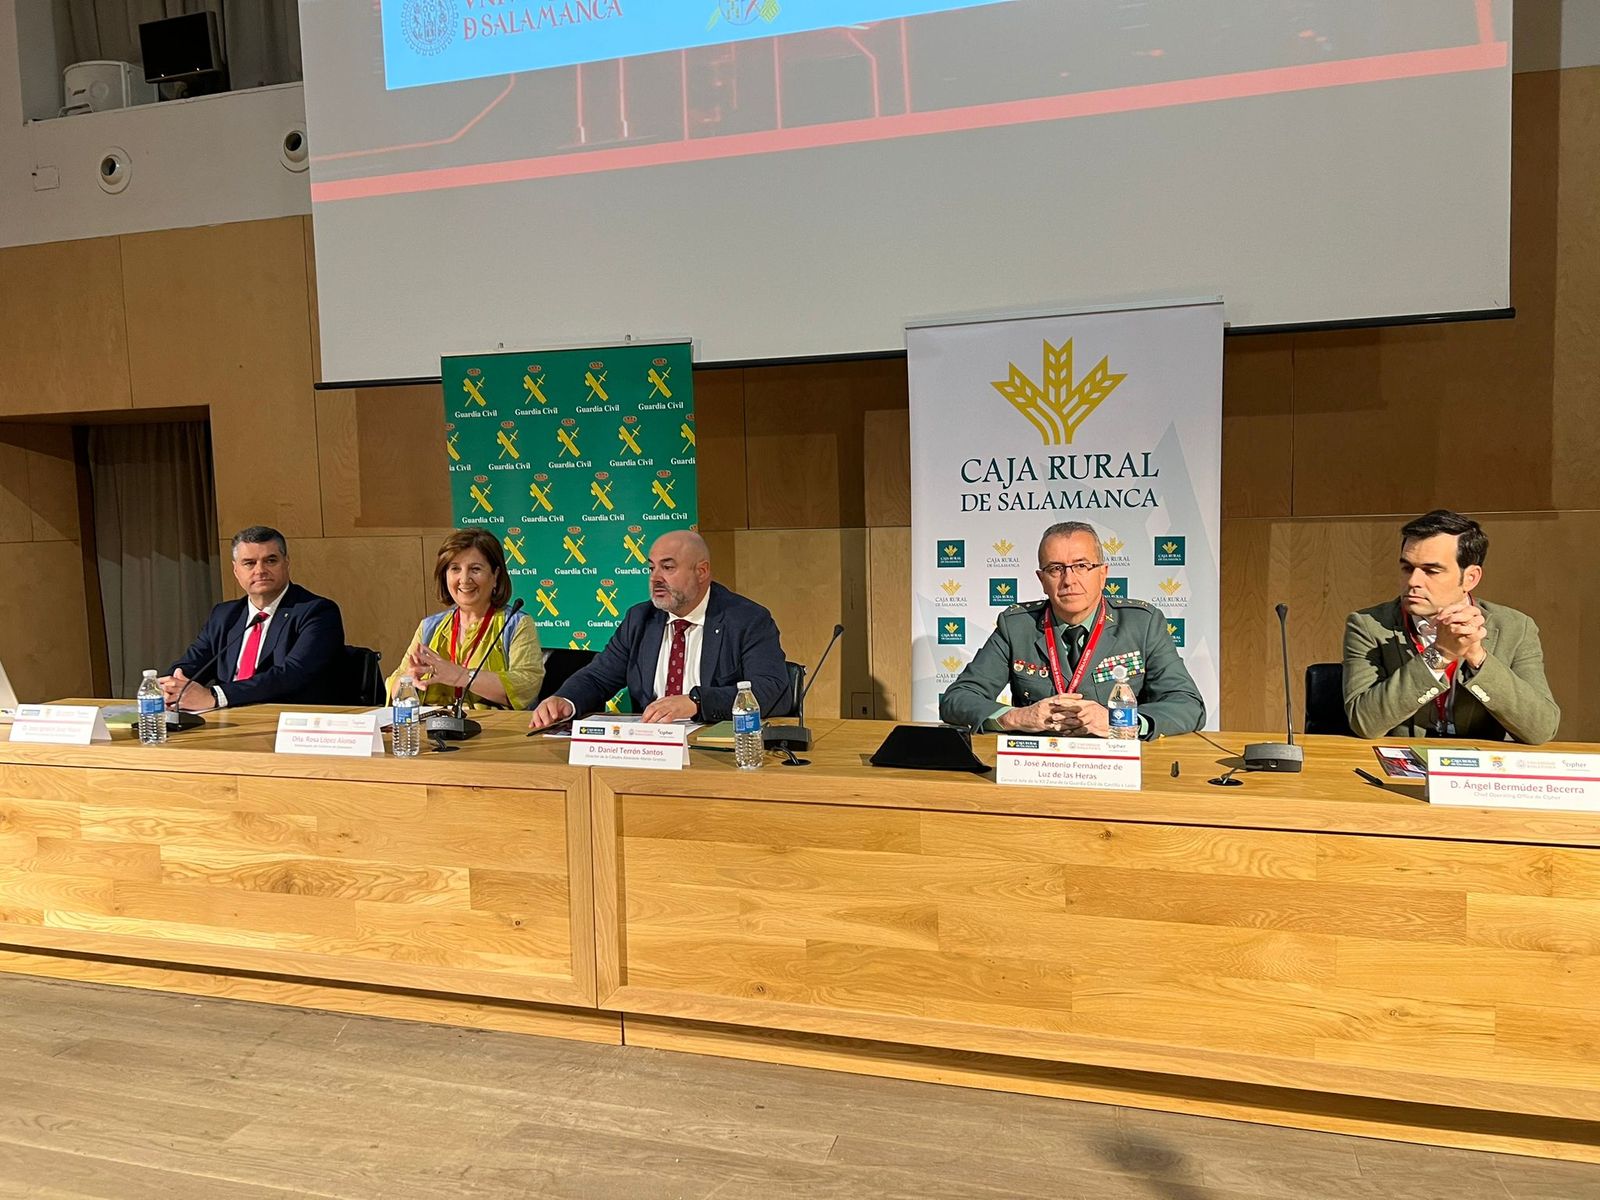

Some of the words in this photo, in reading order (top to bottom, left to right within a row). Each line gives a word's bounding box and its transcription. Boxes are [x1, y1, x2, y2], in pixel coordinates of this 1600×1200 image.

[481, 0, 623, 37] SALAMANCA
[576, 405, 603, 413] Guardia
[604, 404, 620, 412] Civil
[638, 402, 666, 410] Guardia
[667, 401, 684, 409] Civil
[514, 408, 541, 416] Guardia
[542, 407, 558, 415] Civil
[548, 461, 575, 469] Guardia
[609, 459, 636, 467] Guardia
[637, 458, 654, 466] Civil
[670, 457, 696, 465] Guardi
[961, 456, 1038, 489] CAJA
[1048, 452, 1160, 480] RURAL
[961, 493, 992, 512] DE
[998, 488, 1160, 511] SALAMANCA
[462, 516, 488, 524] Guardia
[521, 515, 547, 523] Guardia
[581, 514, 608, 522] Guardia
[642, 513, 670, 521] Guardia
[671, 512, 688, 520] Civil
[614, 567, 641, 575] Guardia
[587, 620, 614, 628] Guardia
[598, 746, 618, 754] Daniel
[620, 747, 641, 755] Terrón
[642, 748, 664, 756] Santos
[1014, 759, 1021, 767] D.
[1024, 760, 1039, 768] José
[1041, 760, 1071, 769] Antonio
[1073, 761, 1111, 770] Fernández
[1113, 762, 1123, 771] de
[1038, 770, 1051, 778] Luz
[1053, 770, 1062, 778] de
[1063, 771, 1073, 779] las
[1075, 772, 1097, 780] Heras
[1450, 780, 1461, 789] D.
[1464, 779, 1491, 791] Ángel
[1494, 782, 1543, 793] Bermúdez
[1546, 784, 1585, 794] Becerra
